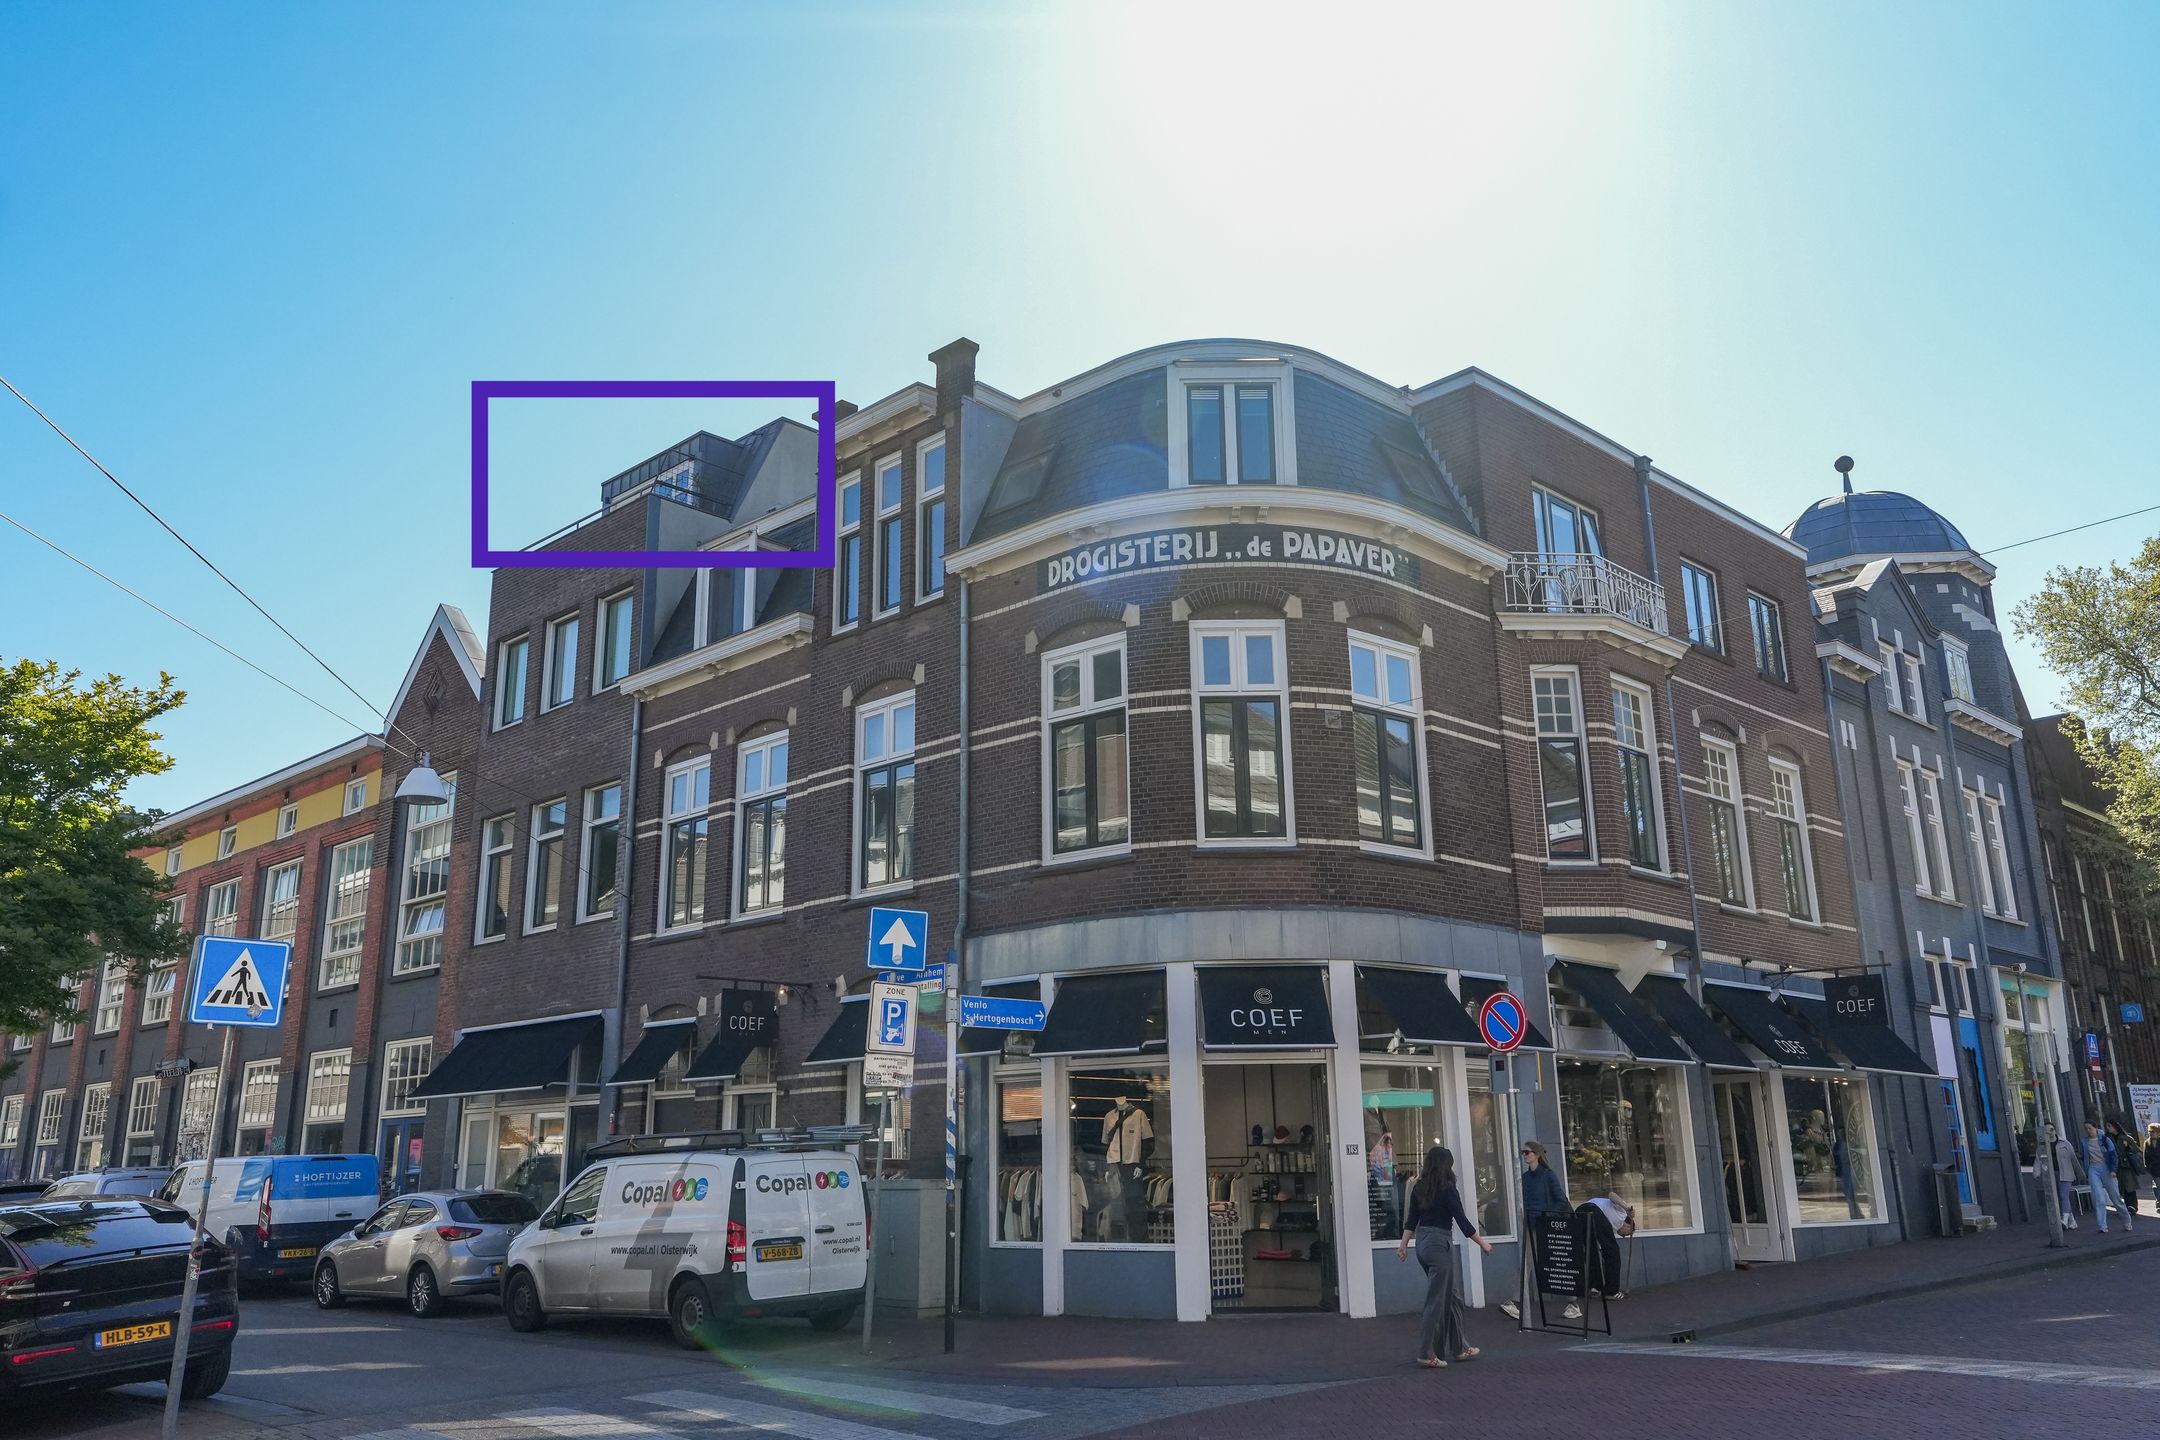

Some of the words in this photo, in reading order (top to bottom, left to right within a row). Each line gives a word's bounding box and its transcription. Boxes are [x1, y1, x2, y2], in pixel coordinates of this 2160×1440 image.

[1048, 530, 1219, 588] DROGISTERIJ
[886, 987, 906, 996] ZONE
[963, 999, 988, 1009] Venlo
[1835, 998, 1875, 1014] COEF
[887, 1002, 902, 1026] P
[1230, 1008, 1303, 1027] COEF
[729, 1015, 765, 1031] COEF
[1774, 1039, 1808, 1055] COEF
[302, 1171, 361, 1182] HOFTIJZER
[755, 1172, 812, 1196] Copal
[622, 1179, 670, 1208] Copal
[1550, 1220, 1568, 1229] COEF
[823, 1235, 861, 1246] www.copal.nl
[611, 1244, 656, 1256] www.copal.nl
[660, 1244, 698, 1258] Oisterwijk
[832, 1245, 861, 1255] Oisterwijk
[106, 1323, 167, 1345] HLB-59-K
